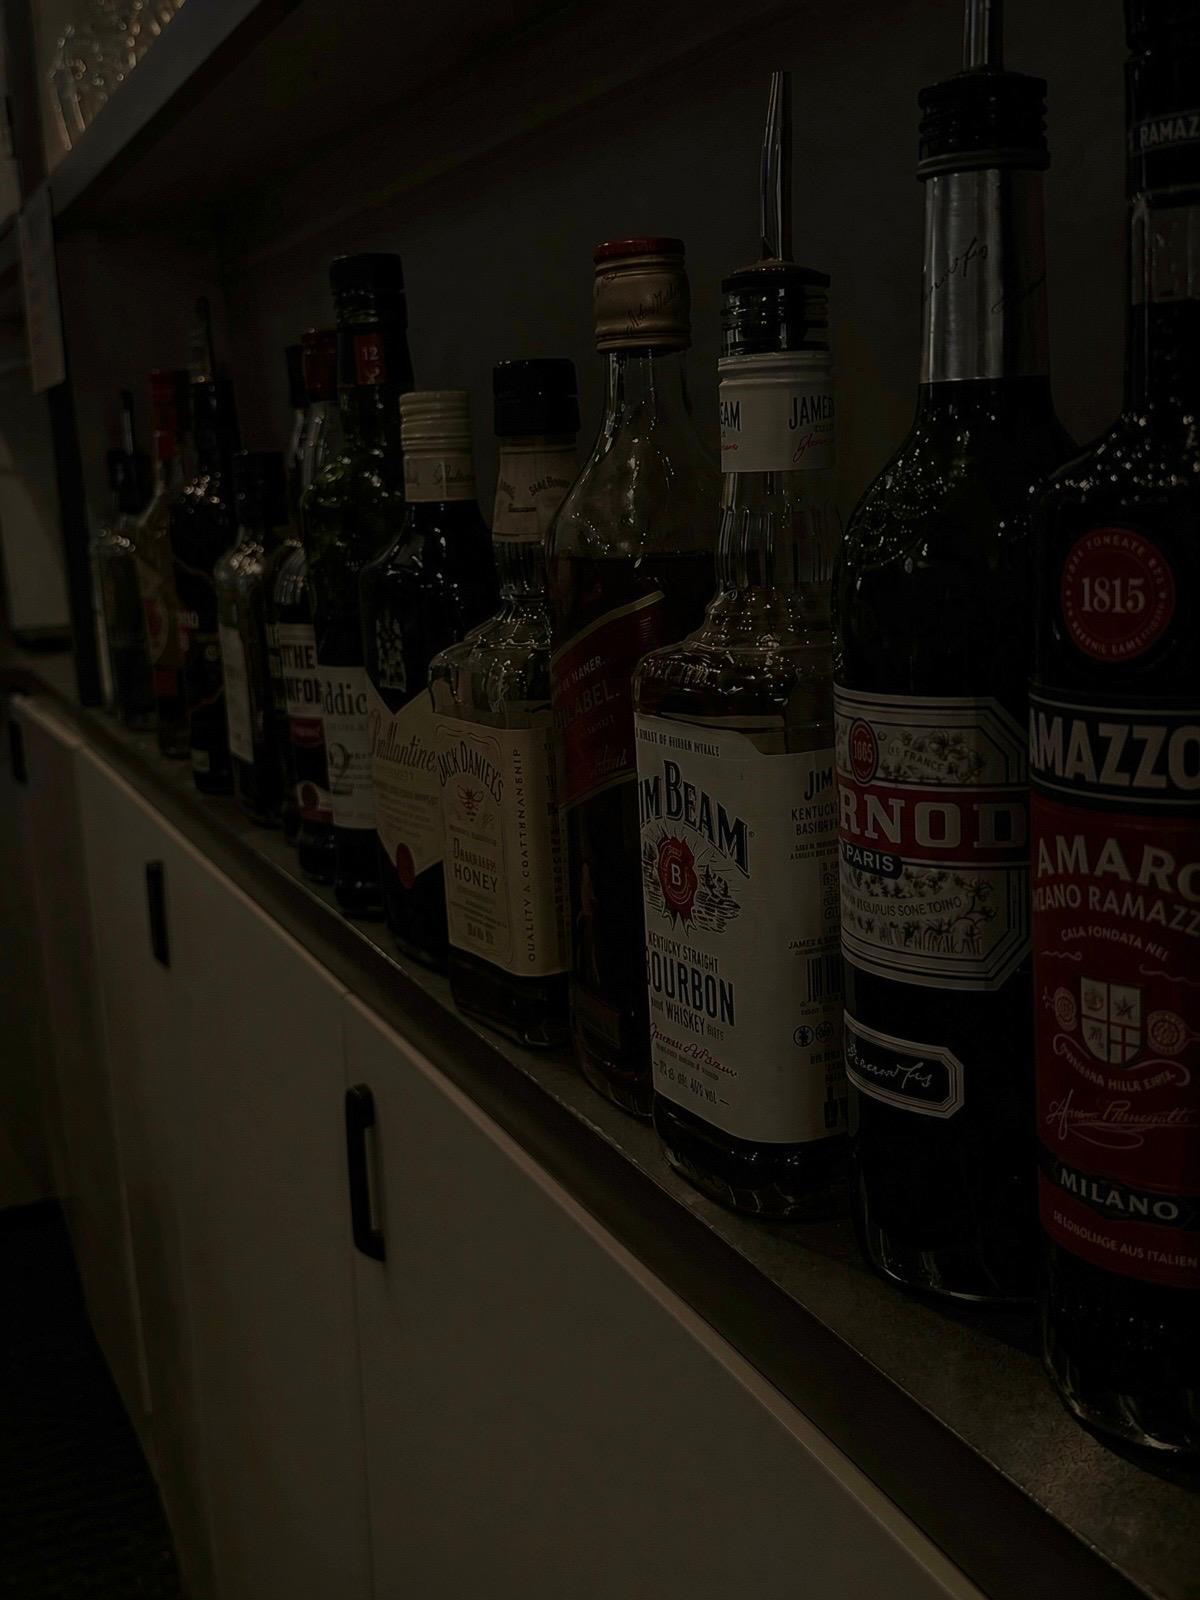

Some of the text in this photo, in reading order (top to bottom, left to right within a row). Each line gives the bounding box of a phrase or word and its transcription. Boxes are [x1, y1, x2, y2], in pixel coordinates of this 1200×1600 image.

[1081, 576, 1146, 614] 1815
[438, 746, 461, 787] JACK
[664, 760, 749, 879] BEAM
[847, 844, 895, 873] PARIS
[454, 862, 498, 894] HONEY
[683, 945, 719, 974] STRAIGHT
[666, 1001, 705, 1036] WHISKEY
[1061, 1167, 1179, 1220] MILANO
